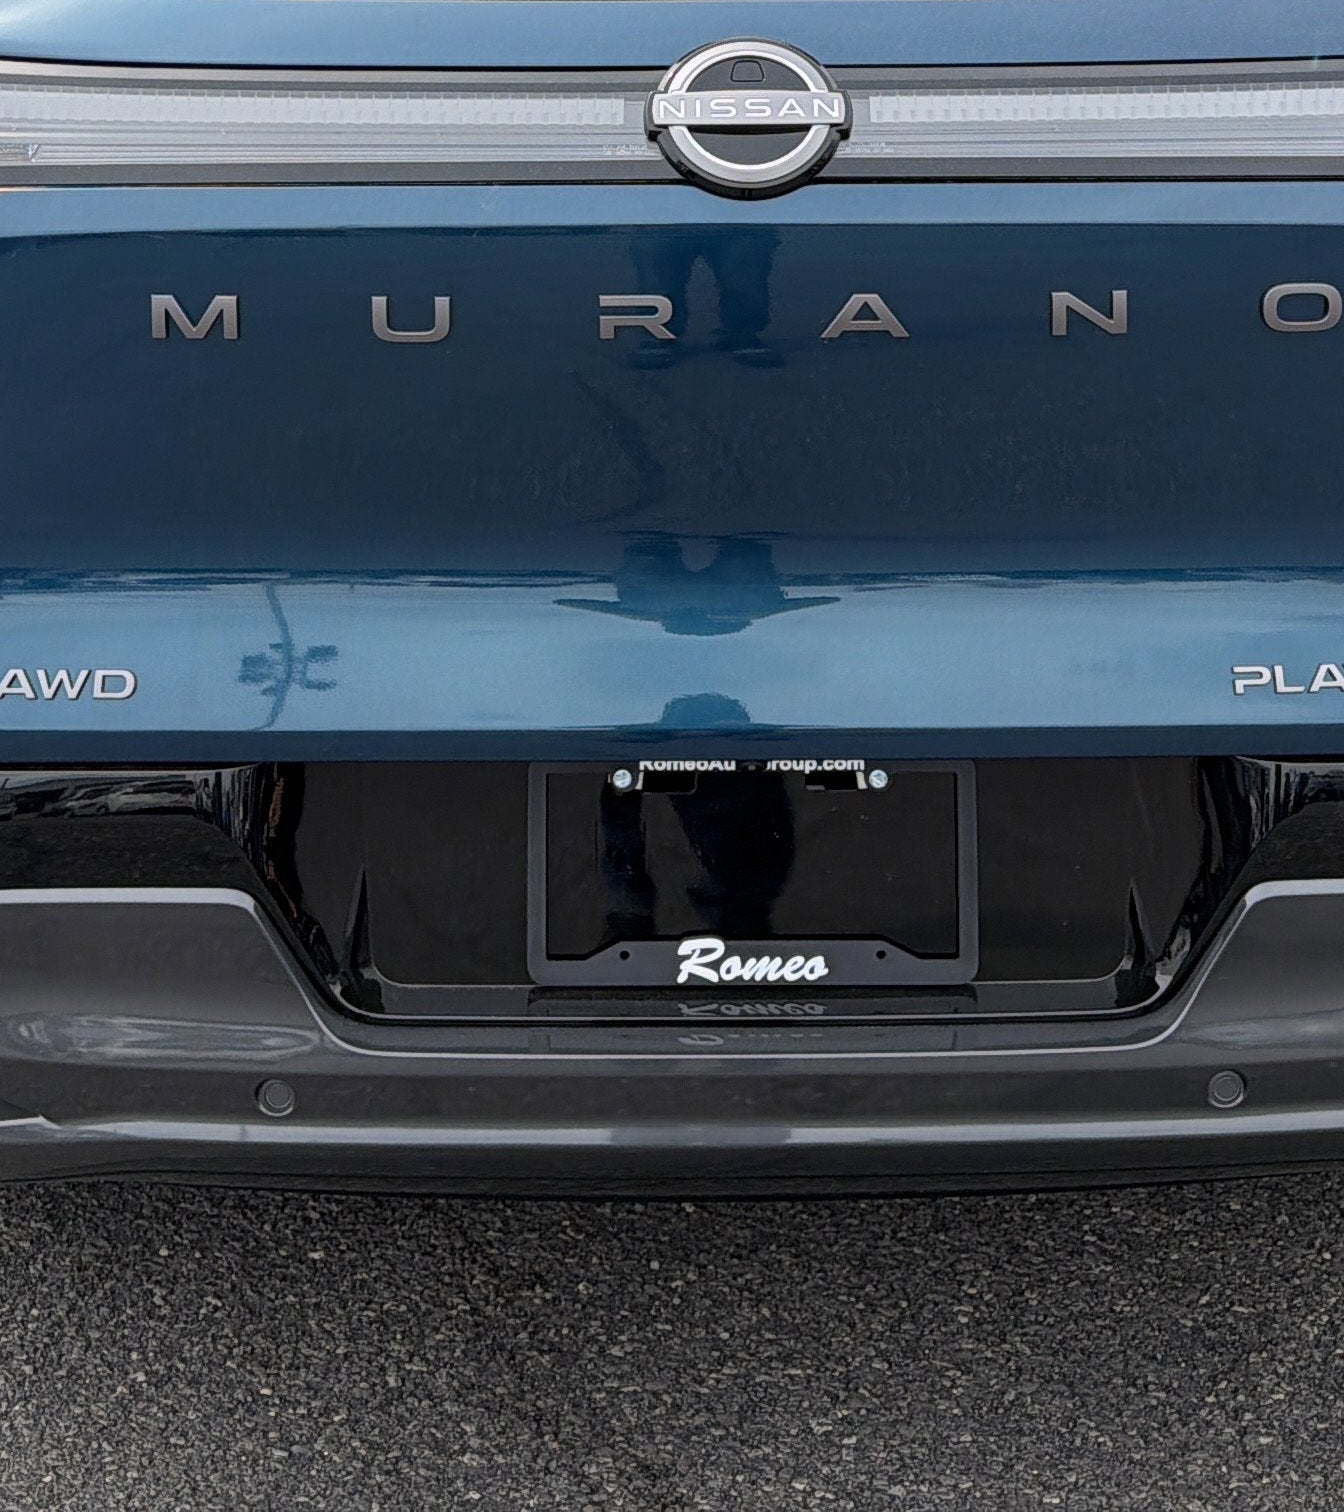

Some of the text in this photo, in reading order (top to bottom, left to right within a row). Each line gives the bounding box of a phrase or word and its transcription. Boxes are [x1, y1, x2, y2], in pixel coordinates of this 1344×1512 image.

[659, 98, 840, 119] NISSAN
[150, 283, 1343, 343] MURANO
[676, 937, 829, 984] Romeo
